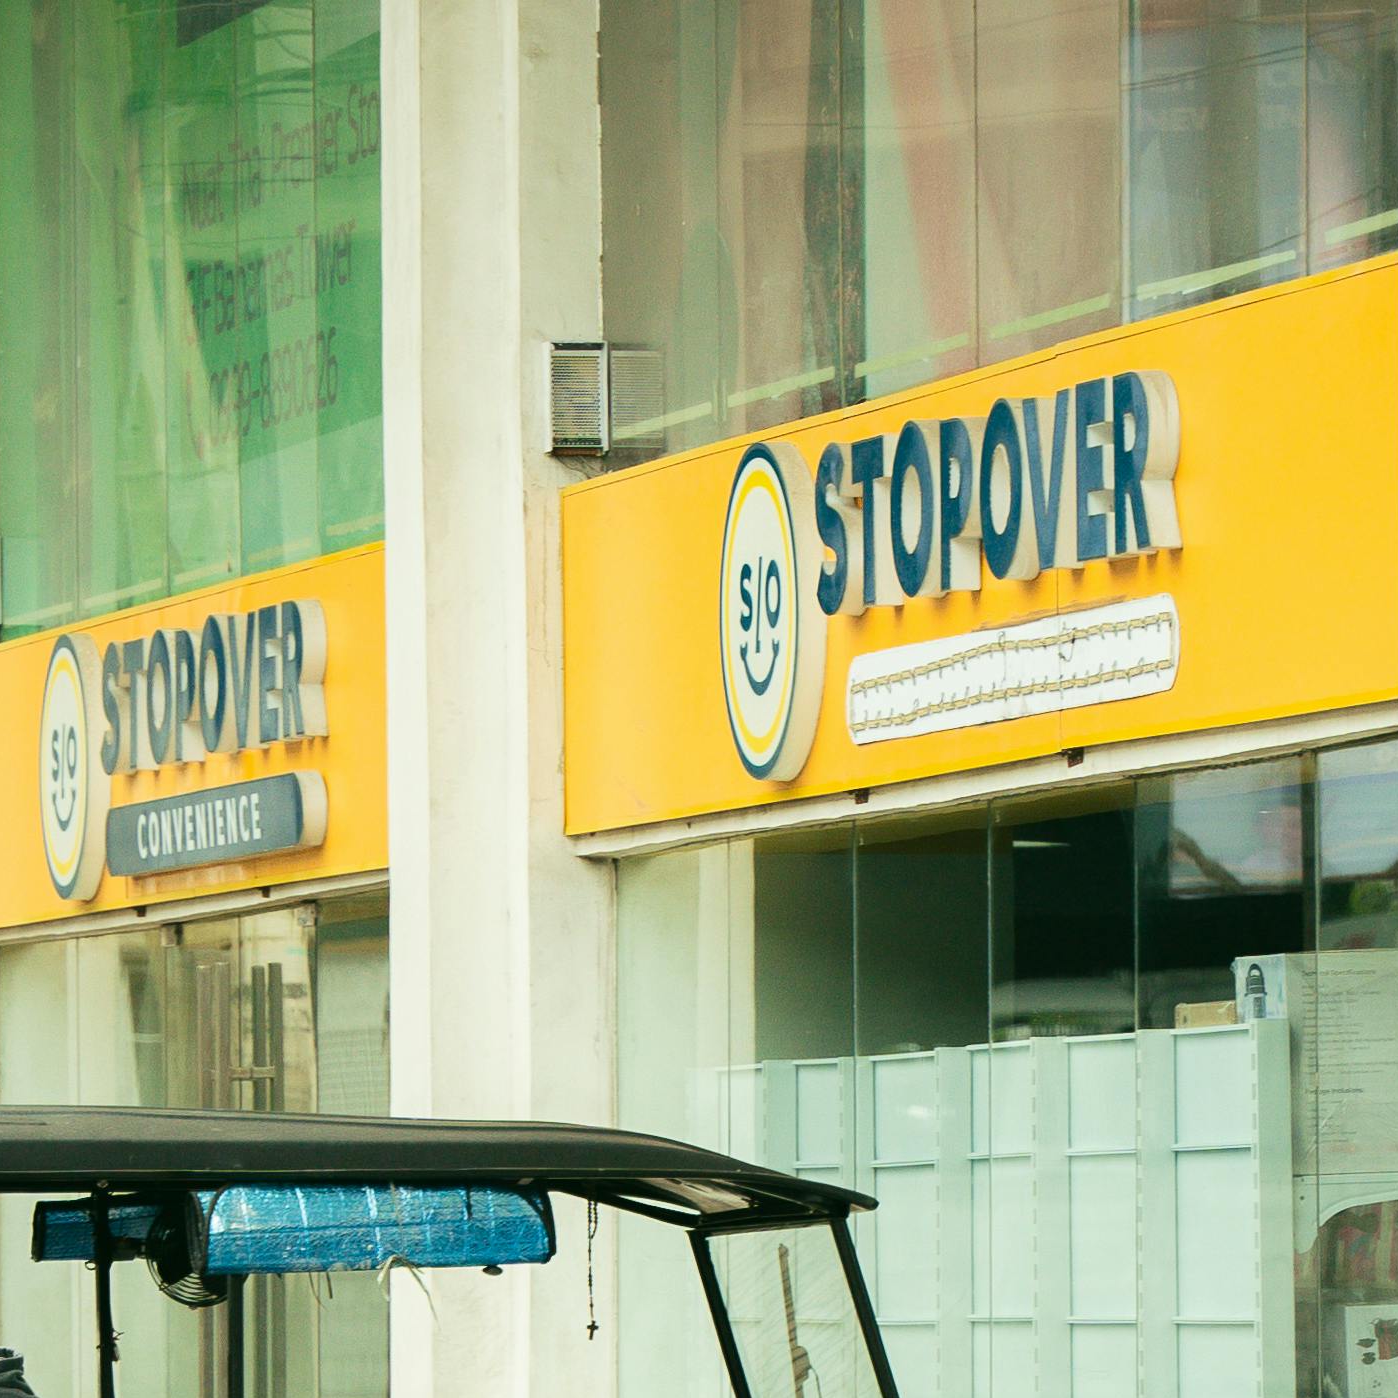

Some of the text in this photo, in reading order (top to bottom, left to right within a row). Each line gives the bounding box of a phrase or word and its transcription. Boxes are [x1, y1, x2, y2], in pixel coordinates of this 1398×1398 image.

[814, 372, 1151, 617] STOPOVER
[103, 600, 306, 776] STOPOVER
[136, 792, 263, 861] CONVENIENCE
